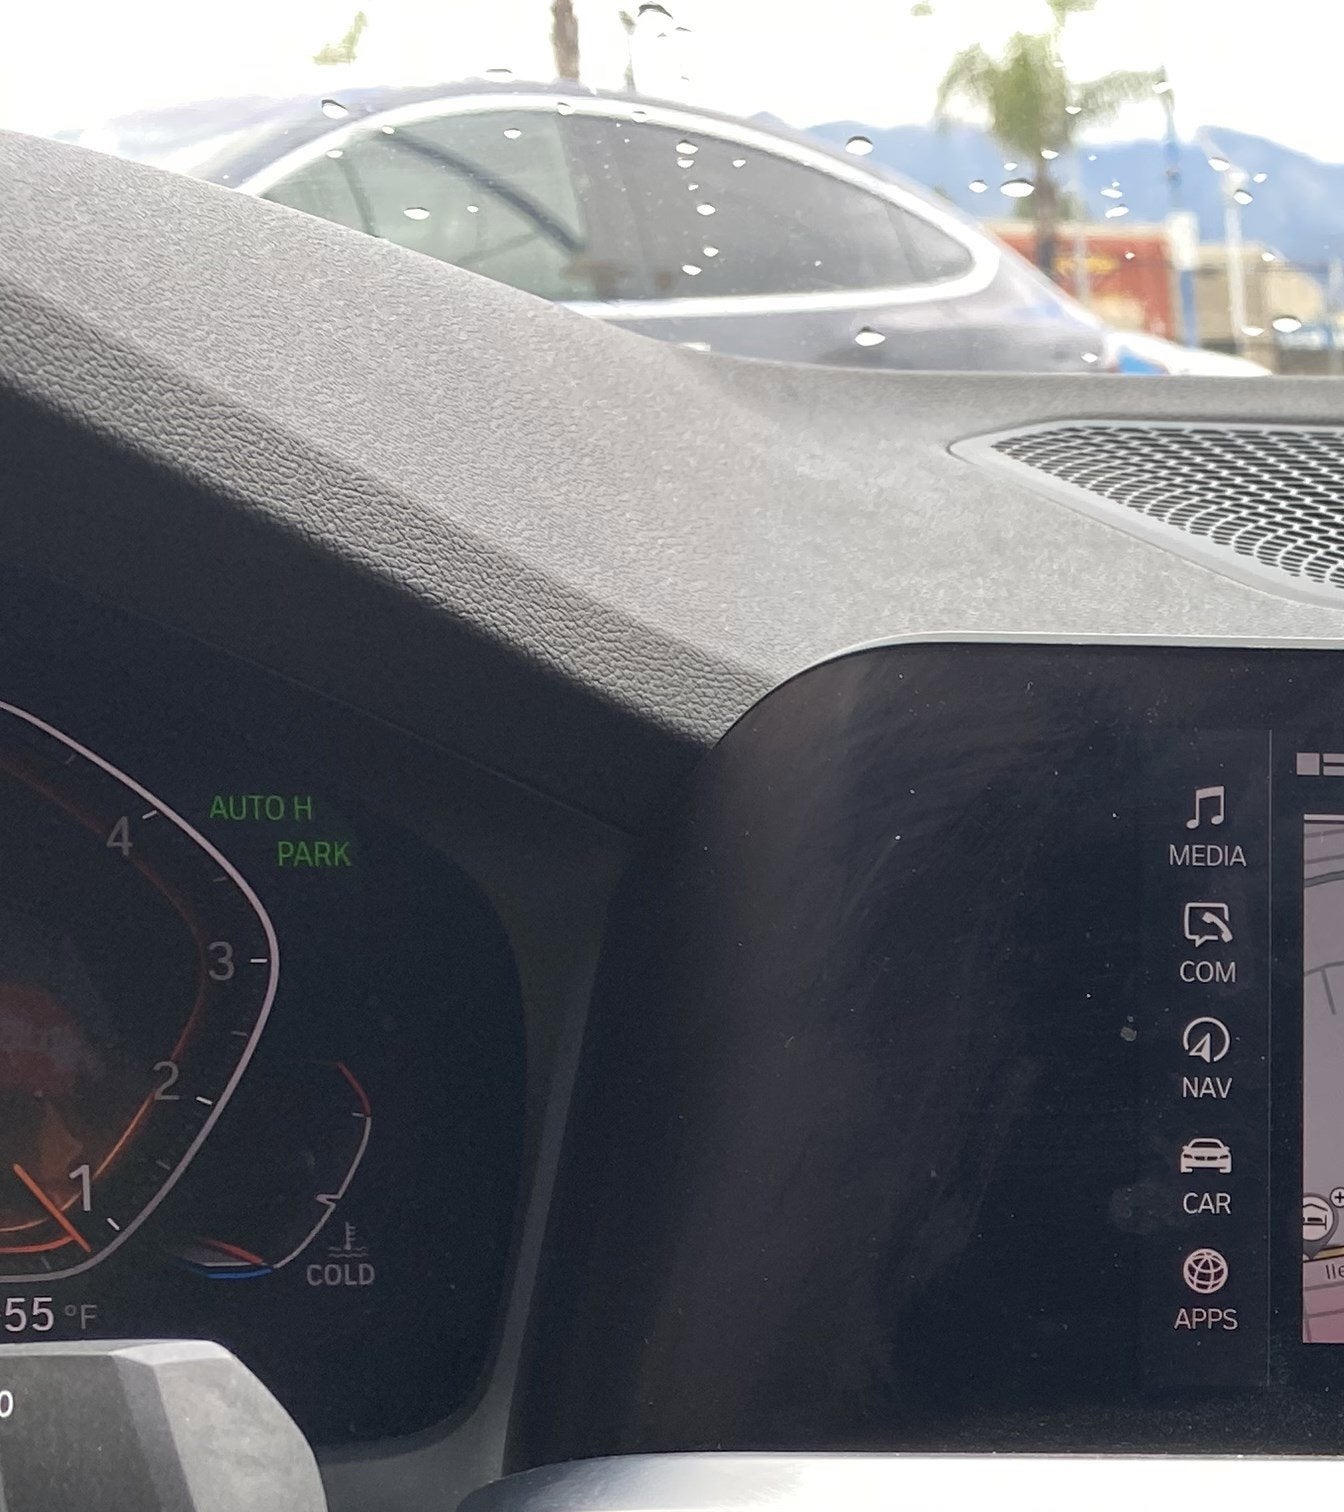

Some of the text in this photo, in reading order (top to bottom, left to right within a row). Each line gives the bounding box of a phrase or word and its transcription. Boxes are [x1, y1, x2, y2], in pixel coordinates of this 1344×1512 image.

[210, 796, 311, 820] AUTO H
[107, 816, 133, 856] 4
[278, 841, 350, 866] PARK
[1170, 844, 1246, 866] MEDIA
[209, 942, 234, 980] 3
[1180, 961, 1235, 982] COM
[153, 1061, 180, 1100] 2
[1183, 1077, 1232, 1098] NAV
[69, 1165, 91, 1211] 1
[1183, 1193, 1230, 1214] CAR
[307, 1264, 374, 1286] COLD
[6, 1298, 53, 1331] 55
[1174, 1308, 1237, 1329] APPS
